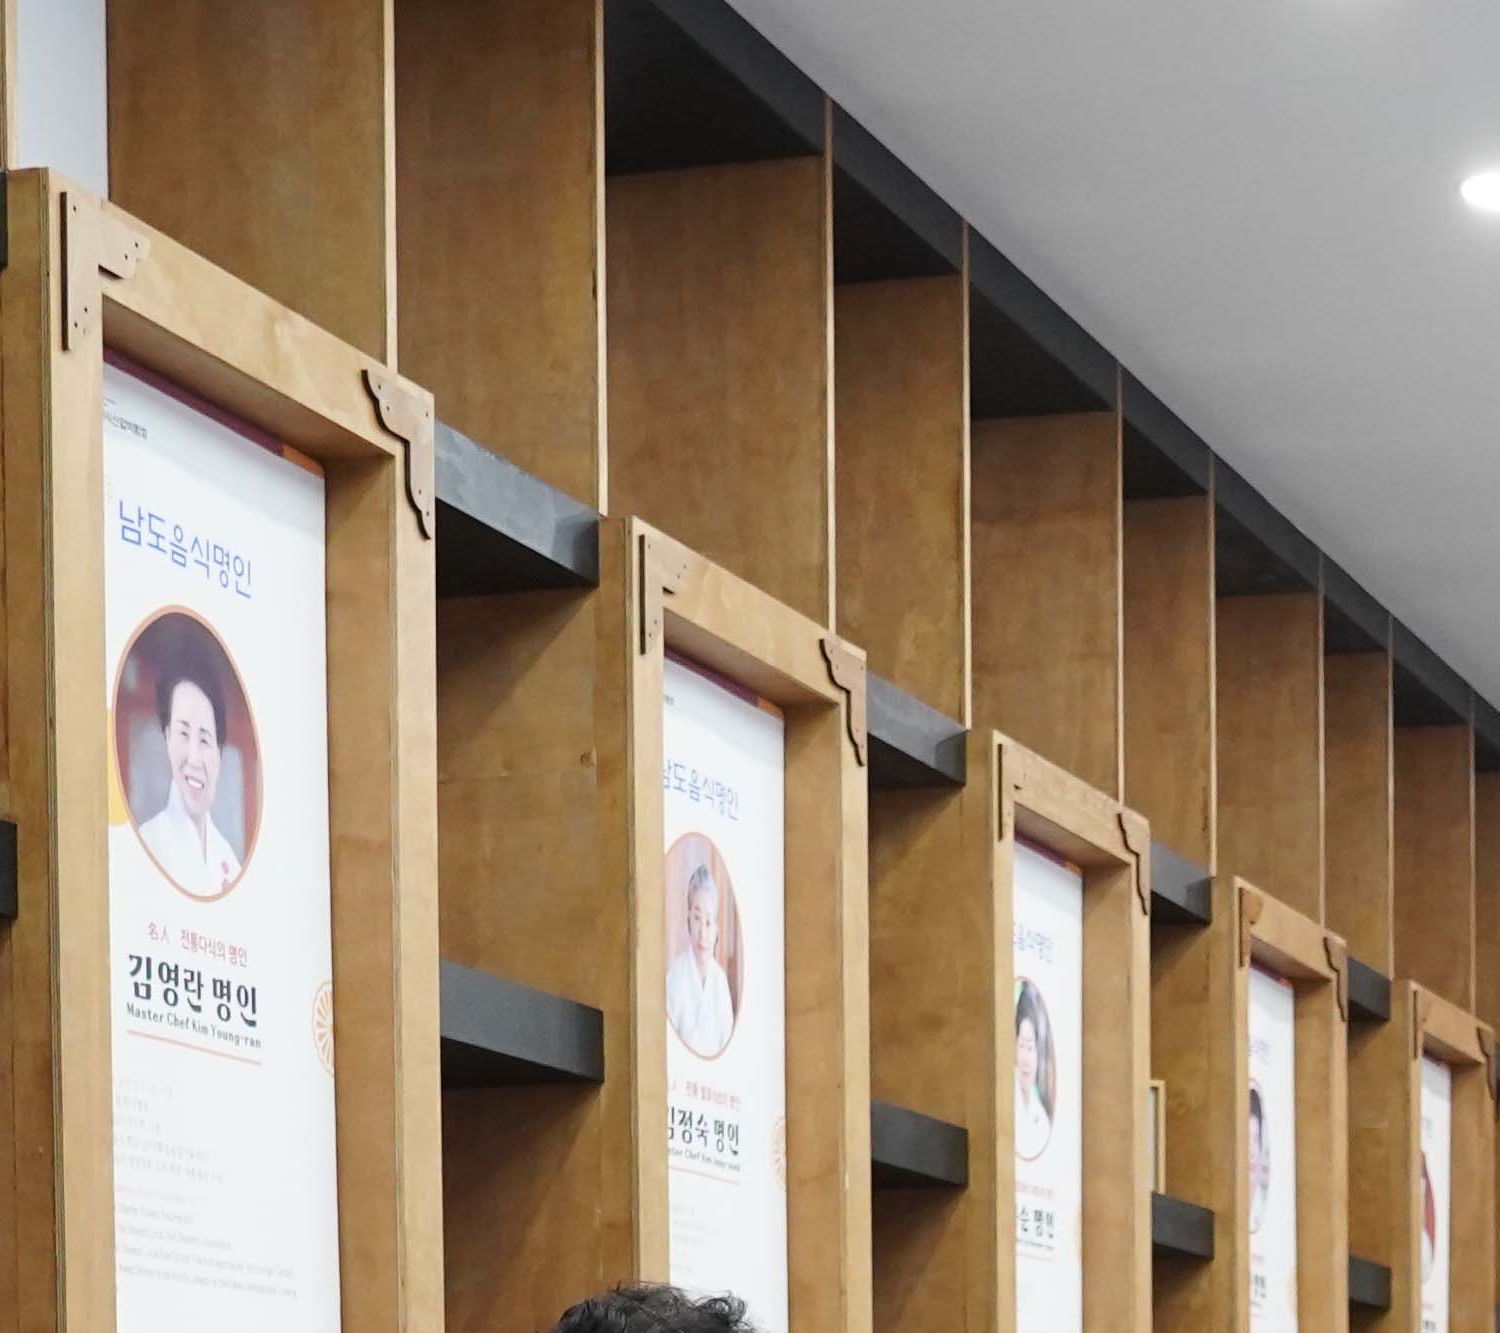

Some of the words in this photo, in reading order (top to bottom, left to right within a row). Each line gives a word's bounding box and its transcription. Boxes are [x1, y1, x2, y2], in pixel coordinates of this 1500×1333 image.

[119, 499, 252, 599] 남도음식명인
[126, 1002, 164, 1024] Master
[166, 1011, 190, 1031] Chef
[191, 1017, 209, 1036] Kim
[128, 954, 204, 1013] 김영란
[212, 976, 257, 1028] 명인
[713, 1119, 740, 1157] 명인
